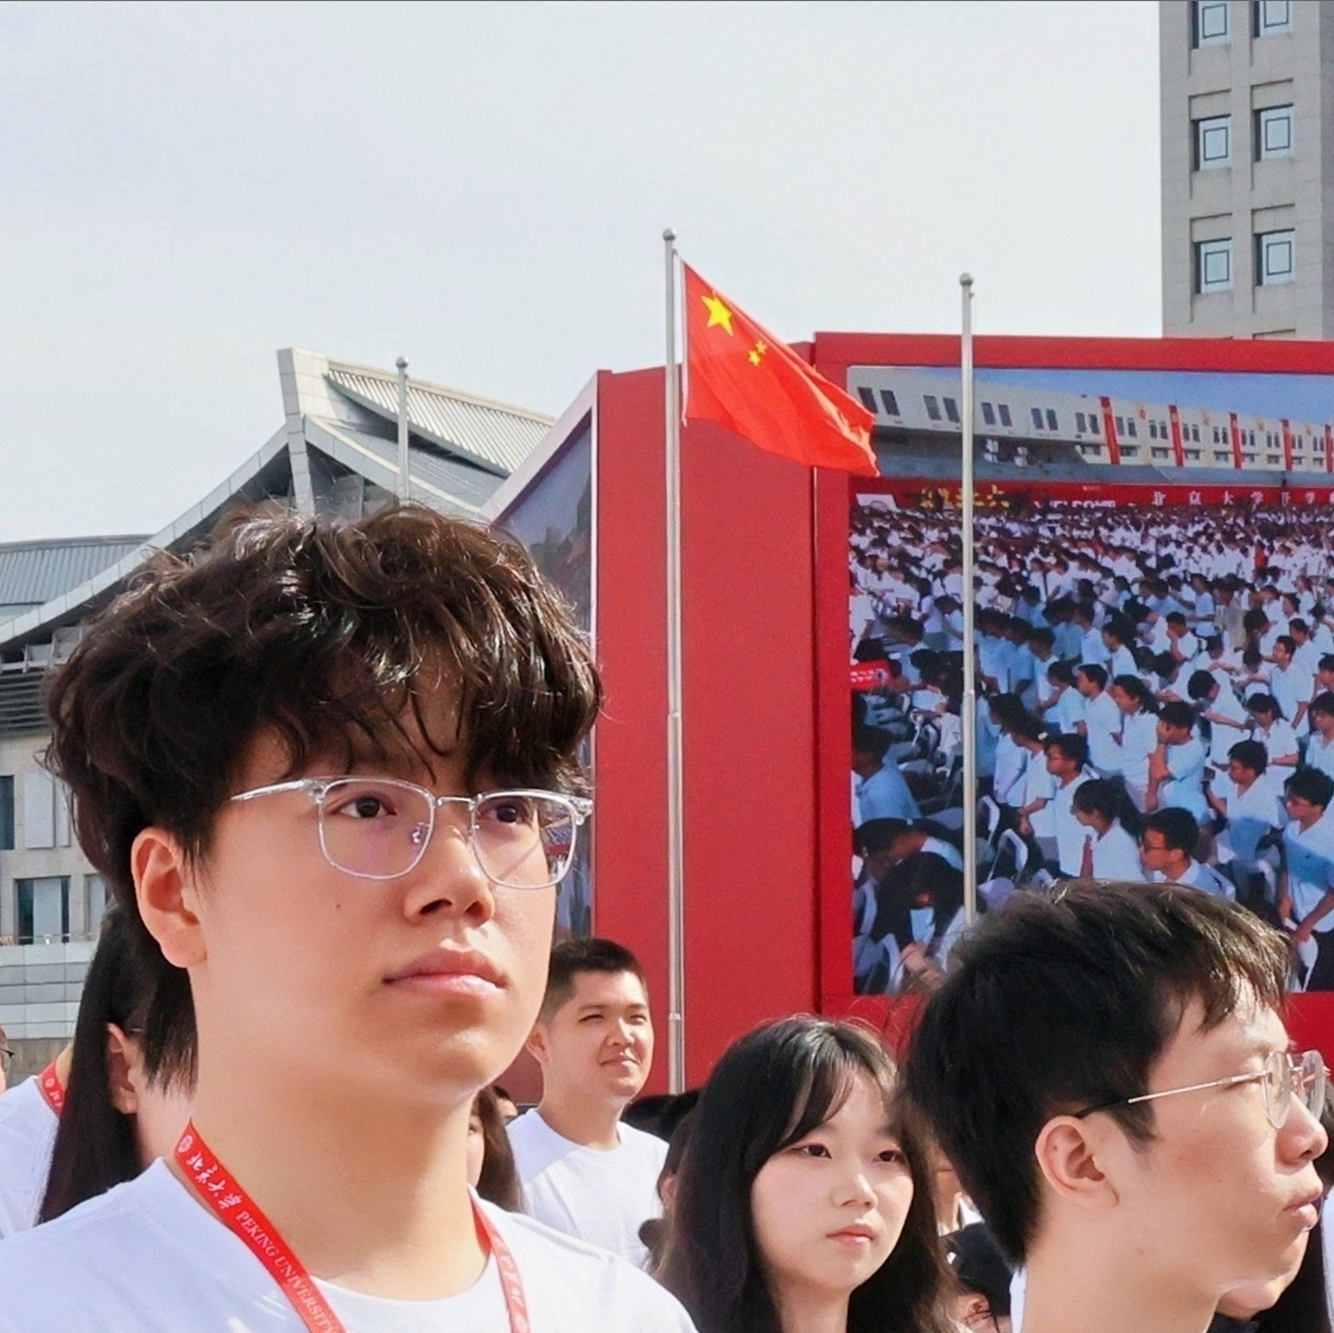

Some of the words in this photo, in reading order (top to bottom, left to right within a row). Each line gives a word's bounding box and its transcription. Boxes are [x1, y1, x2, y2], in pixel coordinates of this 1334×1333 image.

[185, 1152, 242, 1210] 北京大学
[236, 1211, 279, 1257] PEKING
